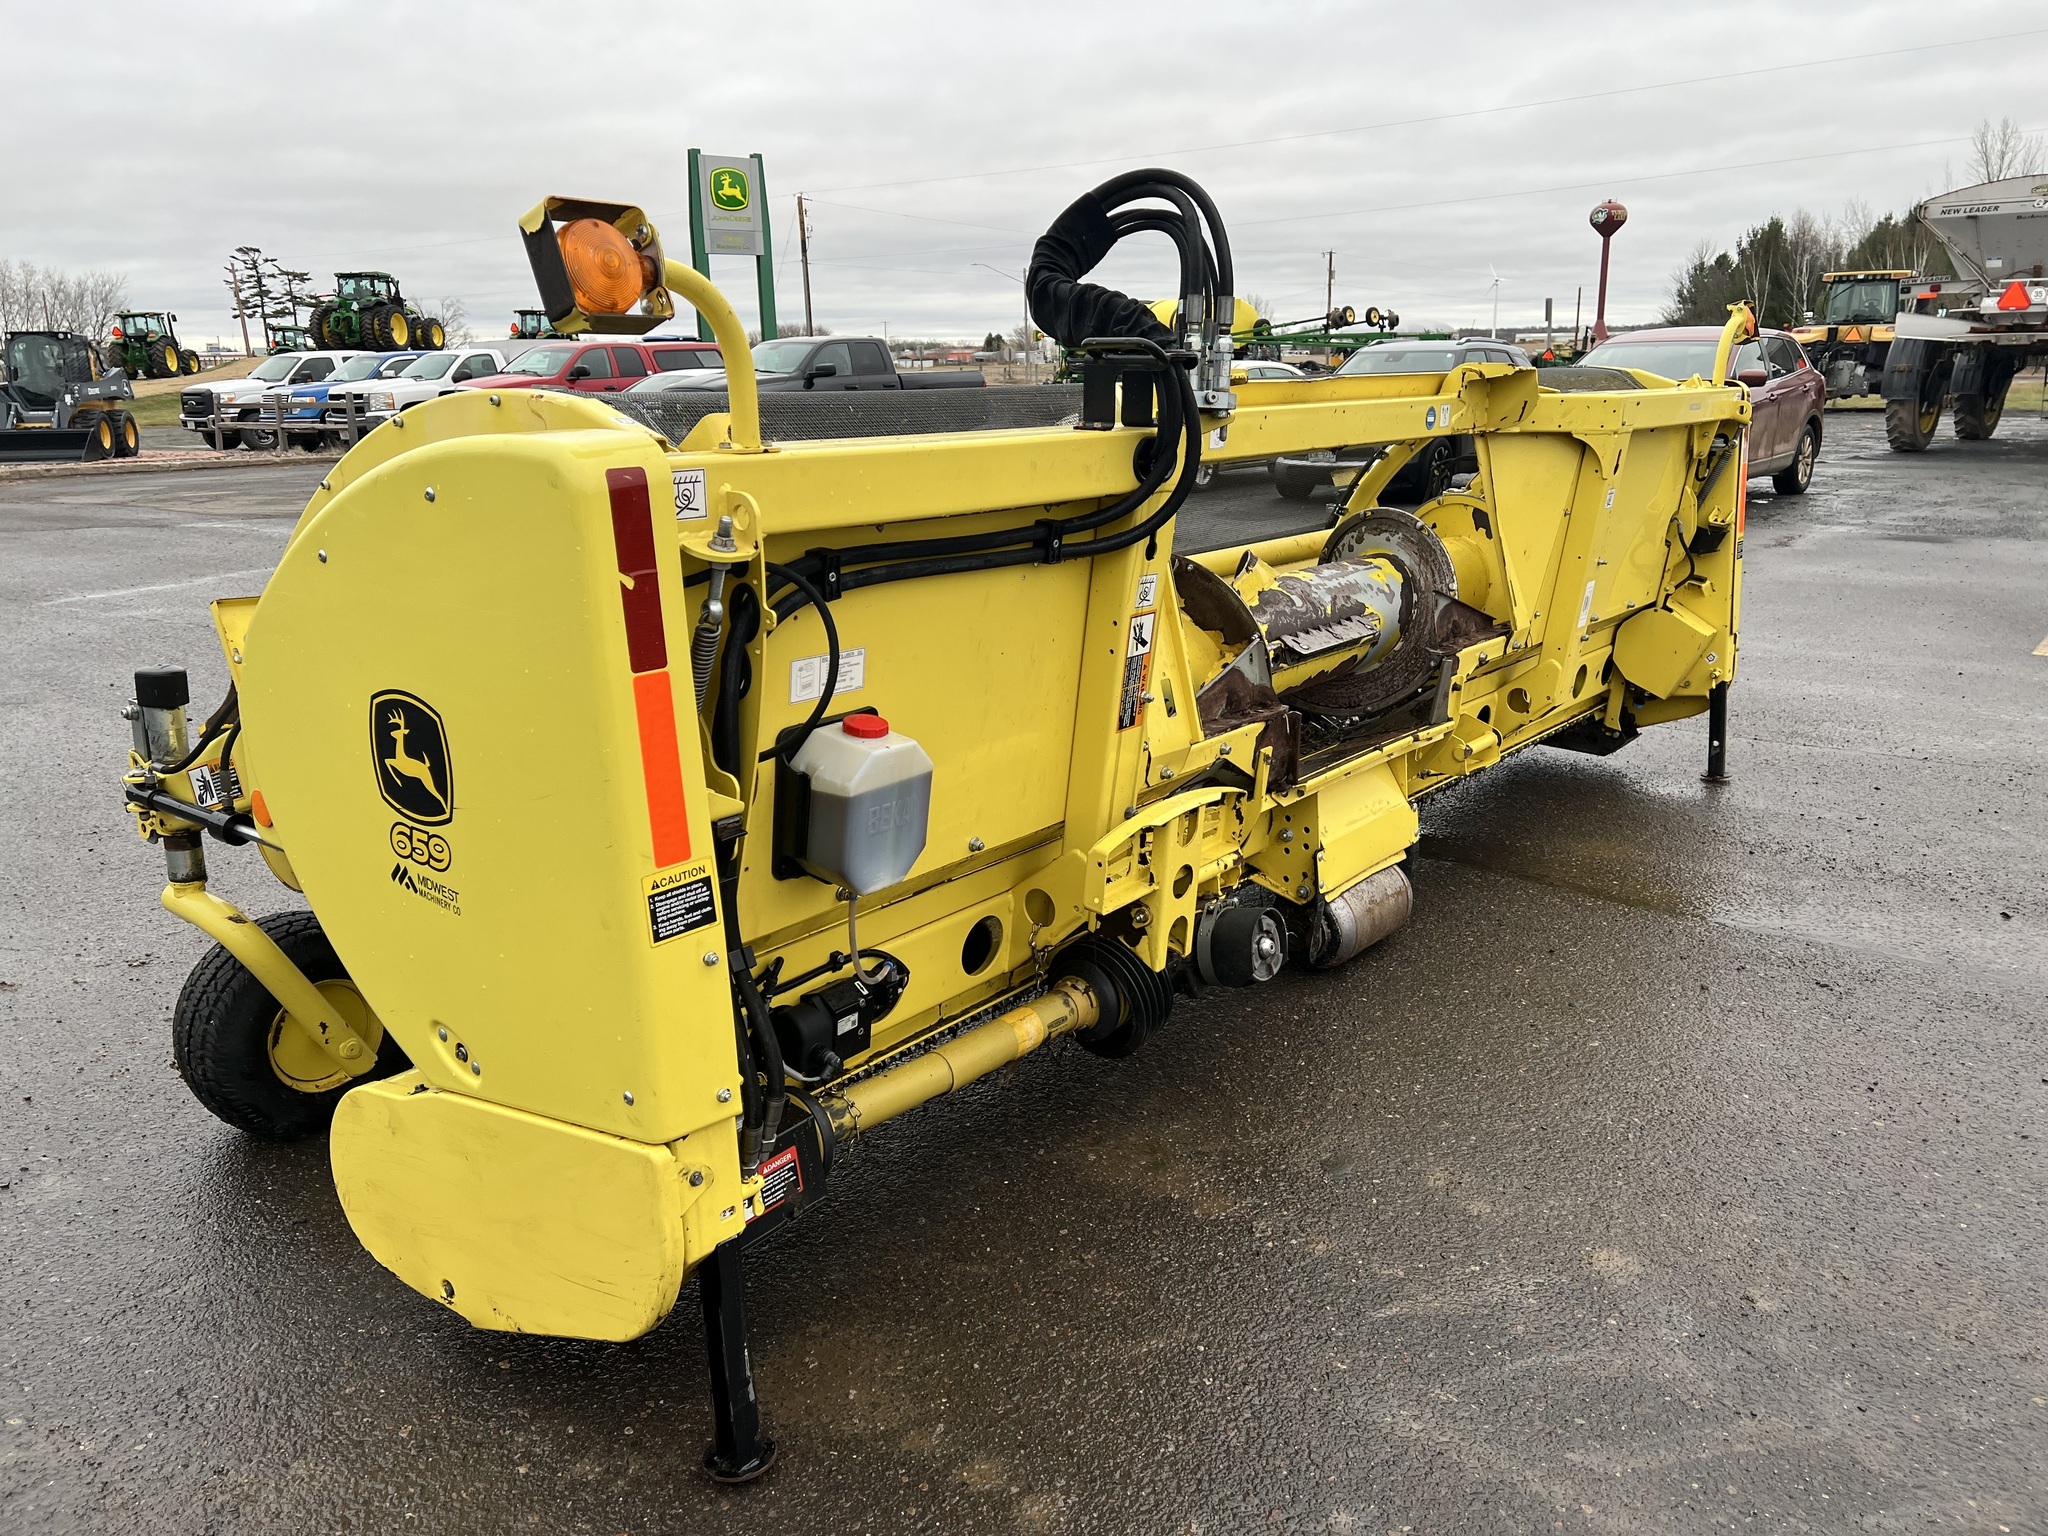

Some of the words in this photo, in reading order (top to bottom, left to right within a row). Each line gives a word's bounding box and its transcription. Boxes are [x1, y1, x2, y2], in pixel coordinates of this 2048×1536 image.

[1940, 208, 1961, 216] NEW
[1963, 205, 2000, 214] LEADER
[2034, 290, 2043, 298] 35
[390, 821, 451, 872] 659
[660, 865, 706, 887] CAUTION
[417, 873, 459, 903] MIDWEST
[418, 888, 451, 911] MACHINERY
[453, 905, 461, 916] CO
[767, 1153, 792, 1172] DANGER
